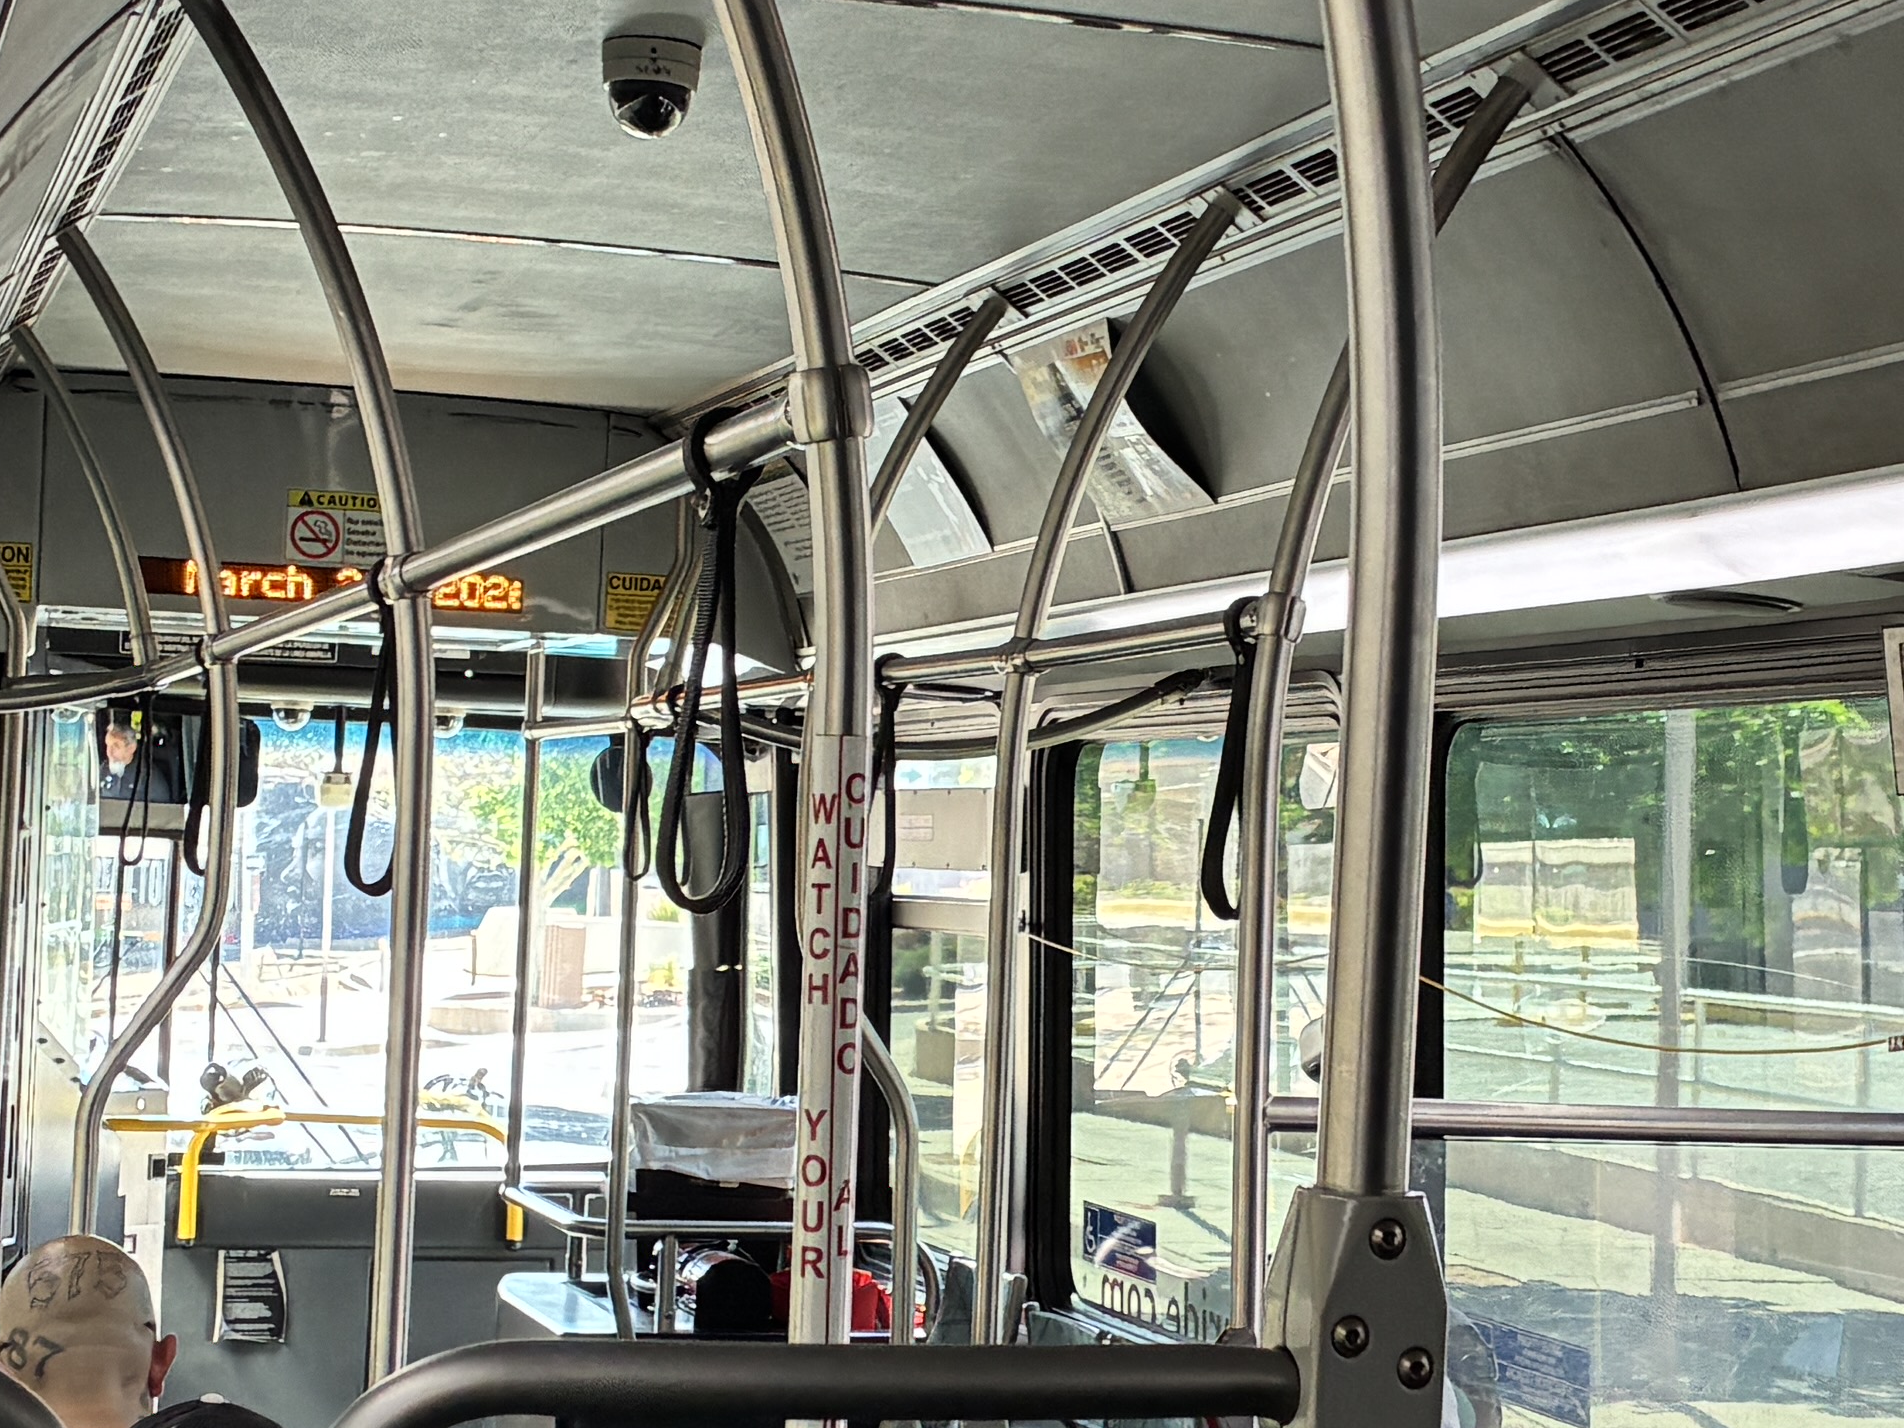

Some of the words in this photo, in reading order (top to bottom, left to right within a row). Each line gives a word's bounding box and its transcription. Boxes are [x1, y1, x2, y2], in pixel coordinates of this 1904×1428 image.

[316, 494, 378, 508] CAUTIO
[609, 575, 663, 591] CUIDA
[808, 793, 837, 1005] WATCH
[801, 1109, 828, 1279] YOUR
